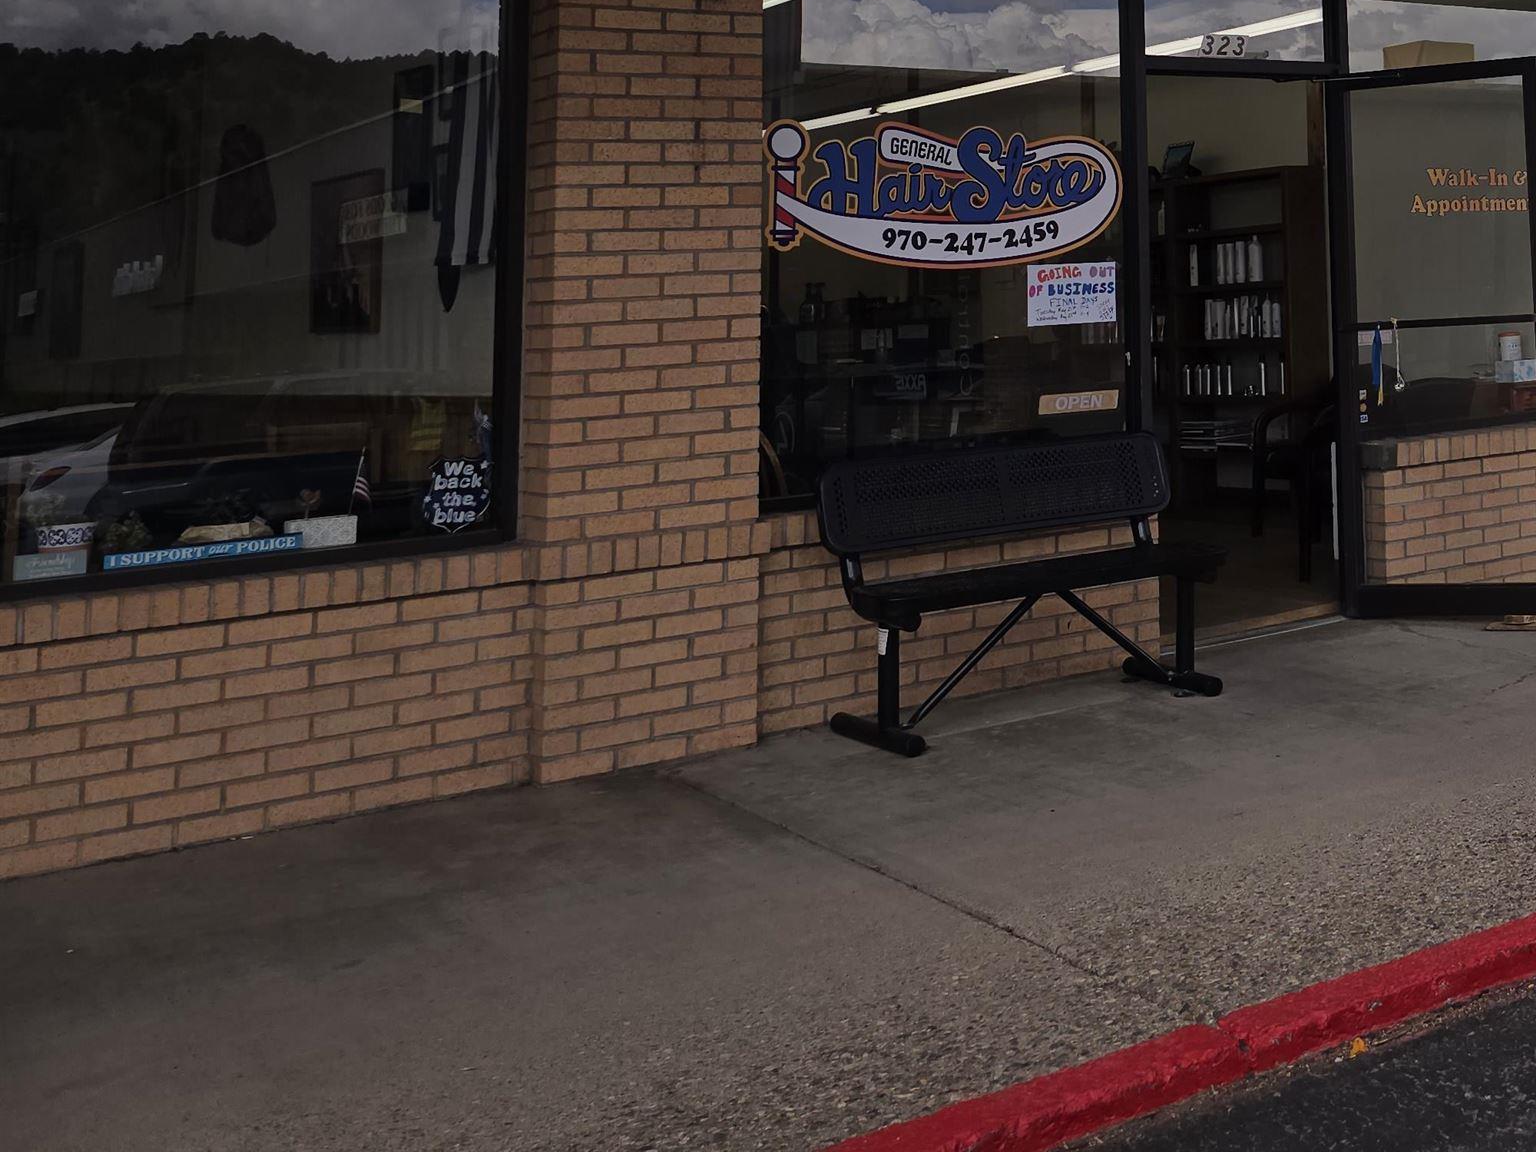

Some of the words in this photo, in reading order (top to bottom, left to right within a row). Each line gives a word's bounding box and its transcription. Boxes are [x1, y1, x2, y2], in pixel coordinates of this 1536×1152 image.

[1201, 35, 1245, 56] 323
[890, 136, 953, 166] GENERAL
[808, 138, 955, 218] Hair
[950, 127, 1102, 223] Store
[1426, 168, 1508, 186] Walk-In
[1411, 194, 1529, 216] Appointmen
[882, 220, 1059, 255] 970-247-2459
[1037, 266, 1082, 283] GOING
[1089, 266, 1115, 278] OUT
[1029, 285, 1043, 298] OF
[1048, 281, 1115, 297] BUSINESS
[1055, 394, 1103, 410] OPEN
[444, 461, 475, 476] We
[434, 473, 483, 491] back
[442, 491, 477, 507] the
[433, 508, 476, 523] blue
[109, 555, 116, 567] I
[120, 546, 206, 566] SUPPORT
[208, 544, 234, 556] our
[235, 536, 296, 553] POLICE
